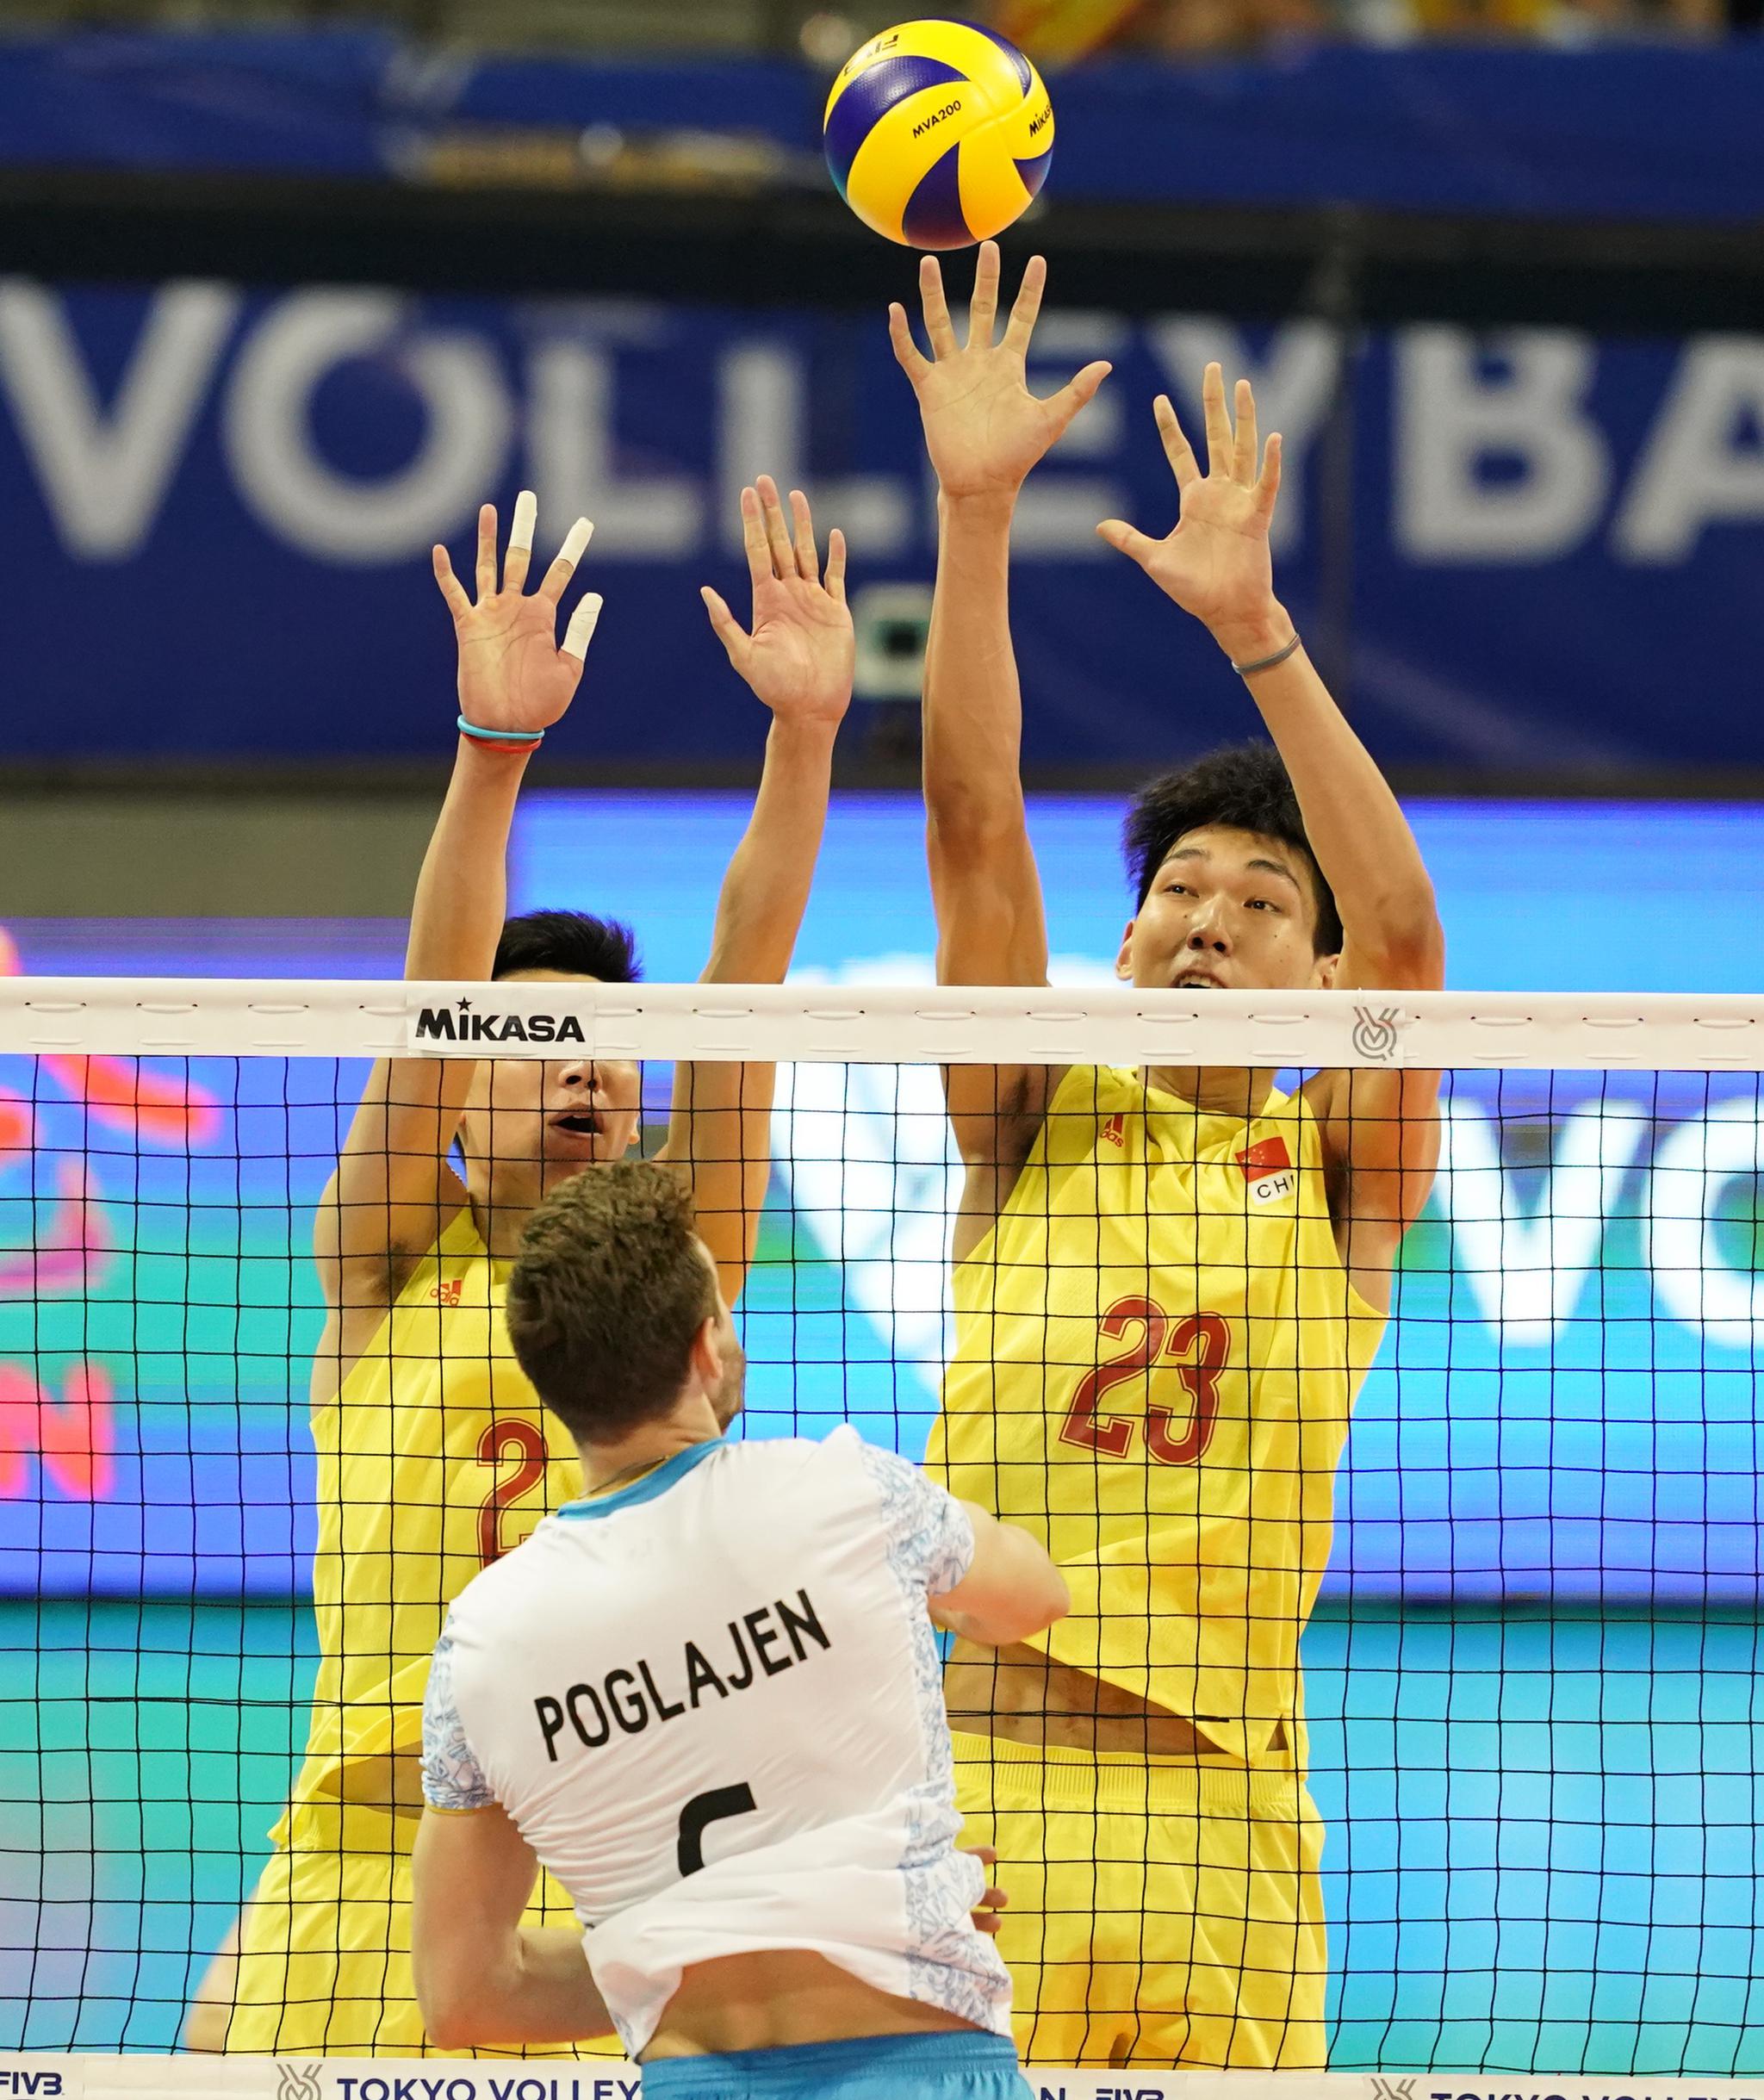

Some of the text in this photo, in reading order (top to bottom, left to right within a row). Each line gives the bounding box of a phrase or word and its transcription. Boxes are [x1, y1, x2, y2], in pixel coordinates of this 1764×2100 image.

[912, 100, 961, 139] MVA200
[1059, 1295, 1231, 1466] 23
[477, 1418, 548, 1573] 2
[535, 1588, 832, 1762] POGLAJEN
[337, 2078, 476, 2100] TOKYO
